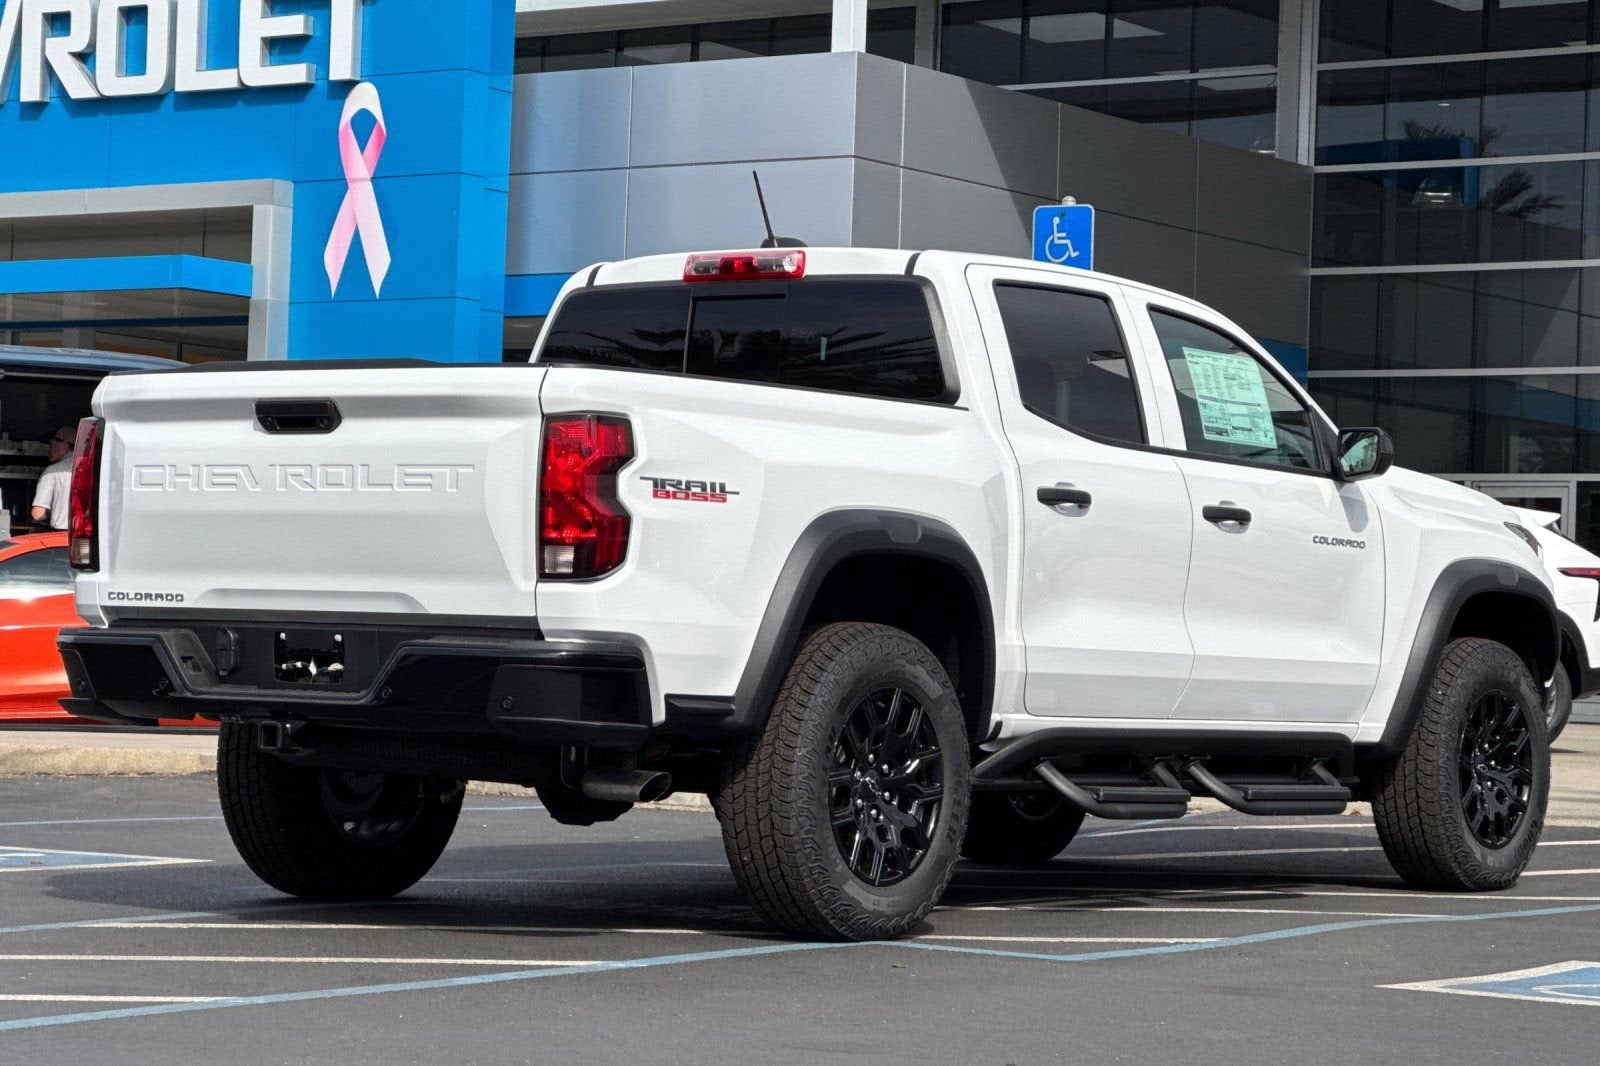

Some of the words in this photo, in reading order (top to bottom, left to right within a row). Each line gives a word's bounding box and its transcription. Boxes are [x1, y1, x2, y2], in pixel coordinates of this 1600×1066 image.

[131, 463, 475, 493] CHEVROLET
[640, 476, 740, 495] TRAIL
[653, 489, 727, 503] BOSS
[1312, 535, 1366, 549] COLORADO
[107, 591, 184, 602] COLORADO
